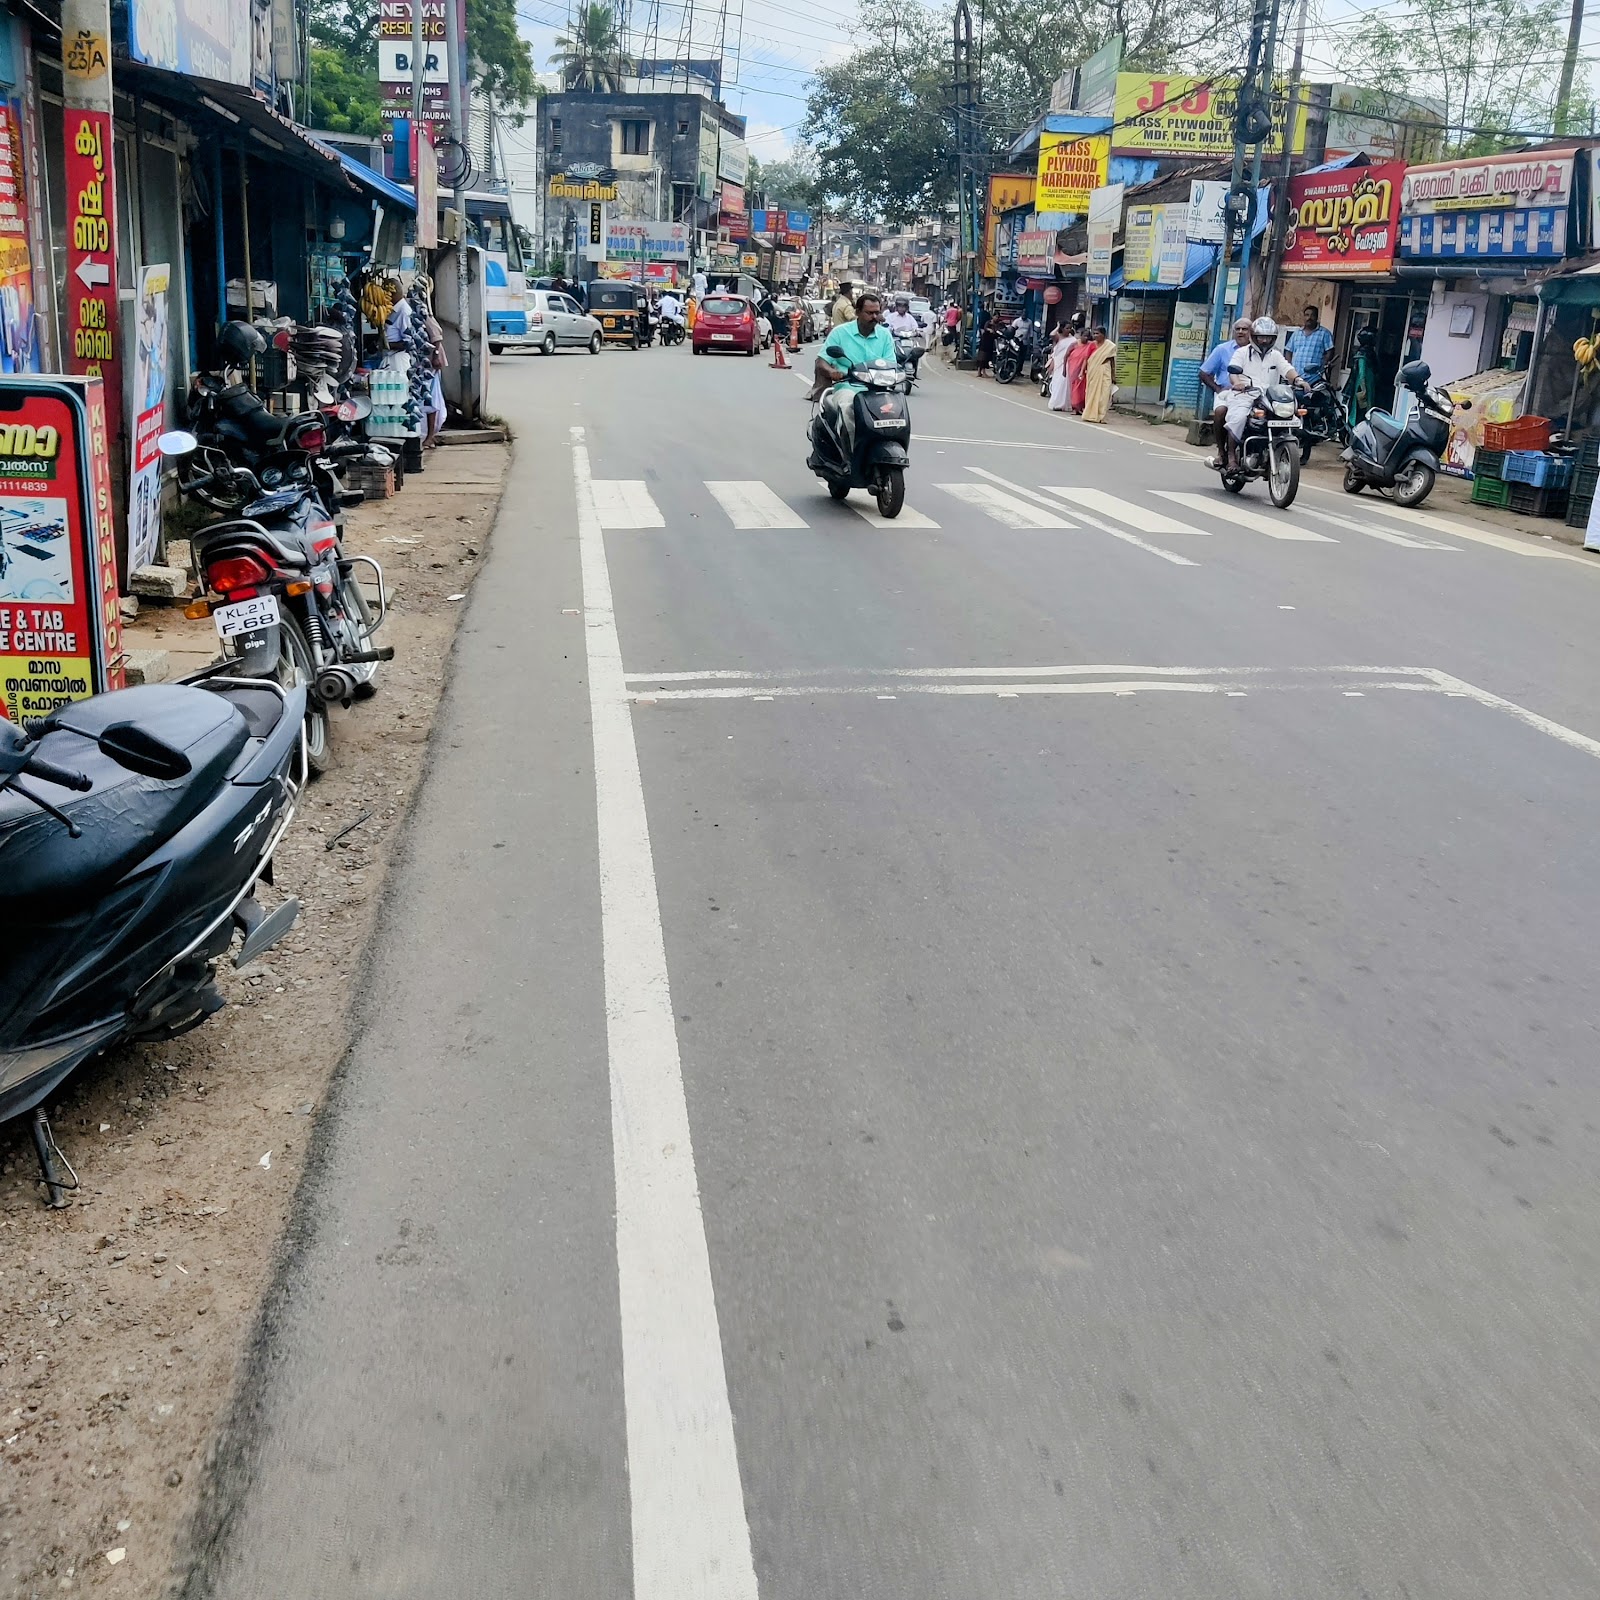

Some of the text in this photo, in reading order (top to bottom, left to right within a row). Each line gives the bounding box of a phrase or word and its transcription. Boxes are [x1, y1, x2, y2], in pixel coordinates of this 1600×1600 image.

[380, 21, 446, 36] RESIENC
[395, 53, 439, 72] BR
[423, 88, 442, 96] OMS
[381, 110, 451, 120] FAMILY RTAURAN
[1124, 116, 1164, 129] GLASS,
[1167, 118, 1225, 131] PLYWOOD,
[1143, 129, 1169, 141] MDF,
[1173, 130, 1196, 142] PVC
[1057, 140, 1091, 156] GLASS
[1047, 156, 1098, 172] PLYWOOD
[1041, 172, 1101, 189] HARDWARE
[1412, 171, 1456, 200] ഭഗവതി
[1459, 166, 1489, 196] ലക്കി
[1304, 183, 1349, 197] SWAMI HOTEL
[1299, 178, 1392, 235] സ്വാമി
[609, 225, 650, 237] HOTEL
[1355, 228, 1389, 254] ഹോട്ടൽ
[90, 403, 114, 592] KRISHNA
[16, 609, 28, 630] &
[31, 610, 63, 630] TAB
[221, 613, 275, 635] F.68
[13, 632, 77, 652] CENTRE
[28, 660, 61, 675] മാസ
[5, 676, 87, 693] തവണയിൽ
